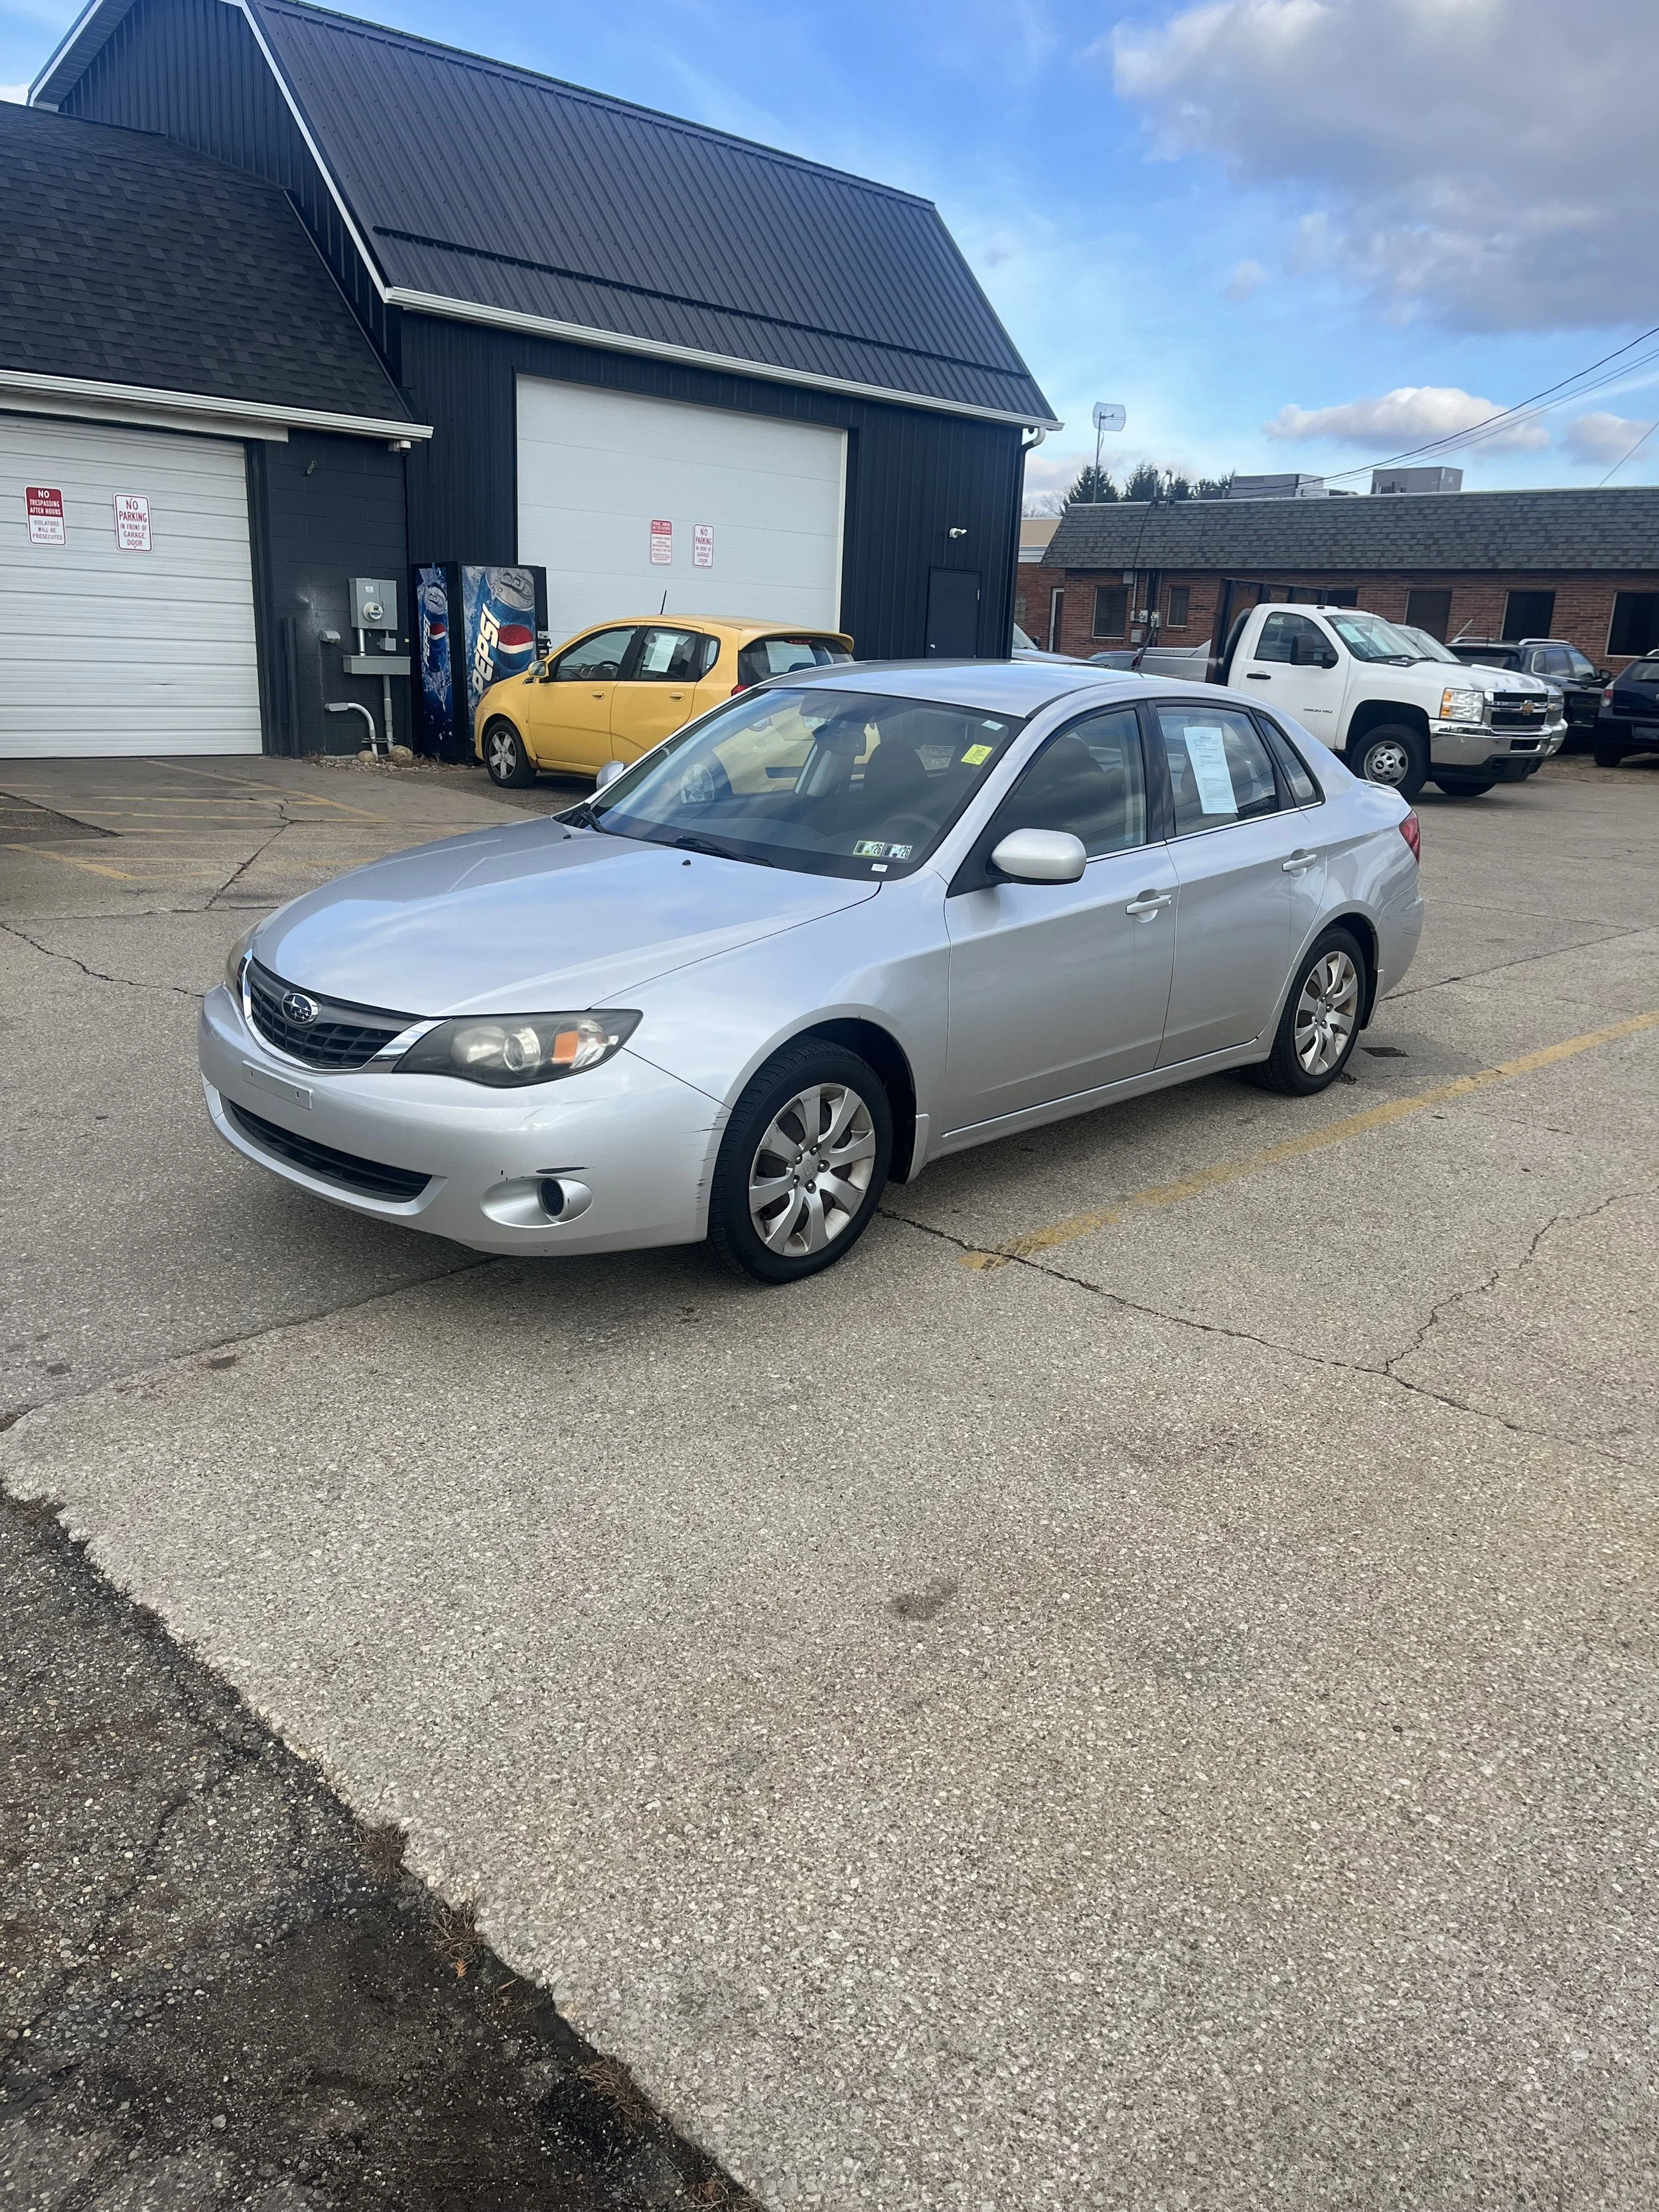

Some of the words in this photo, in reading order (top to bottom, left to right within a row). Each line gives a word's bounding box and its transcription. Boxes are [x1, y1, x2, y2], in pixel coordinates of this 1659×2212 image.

[38, 490, 50, 498] NO
[29, 498, 60, 508] TRESPASSING
[126, 500, 138, 510] NO
[119, 510, 147, 522] PARKING
[695, 536, 712, 545] PARKING
[472, 603, 501, 694] PEPSI
[873, 844, 883, 855] 26
[901, 846, 911, 857] 26
